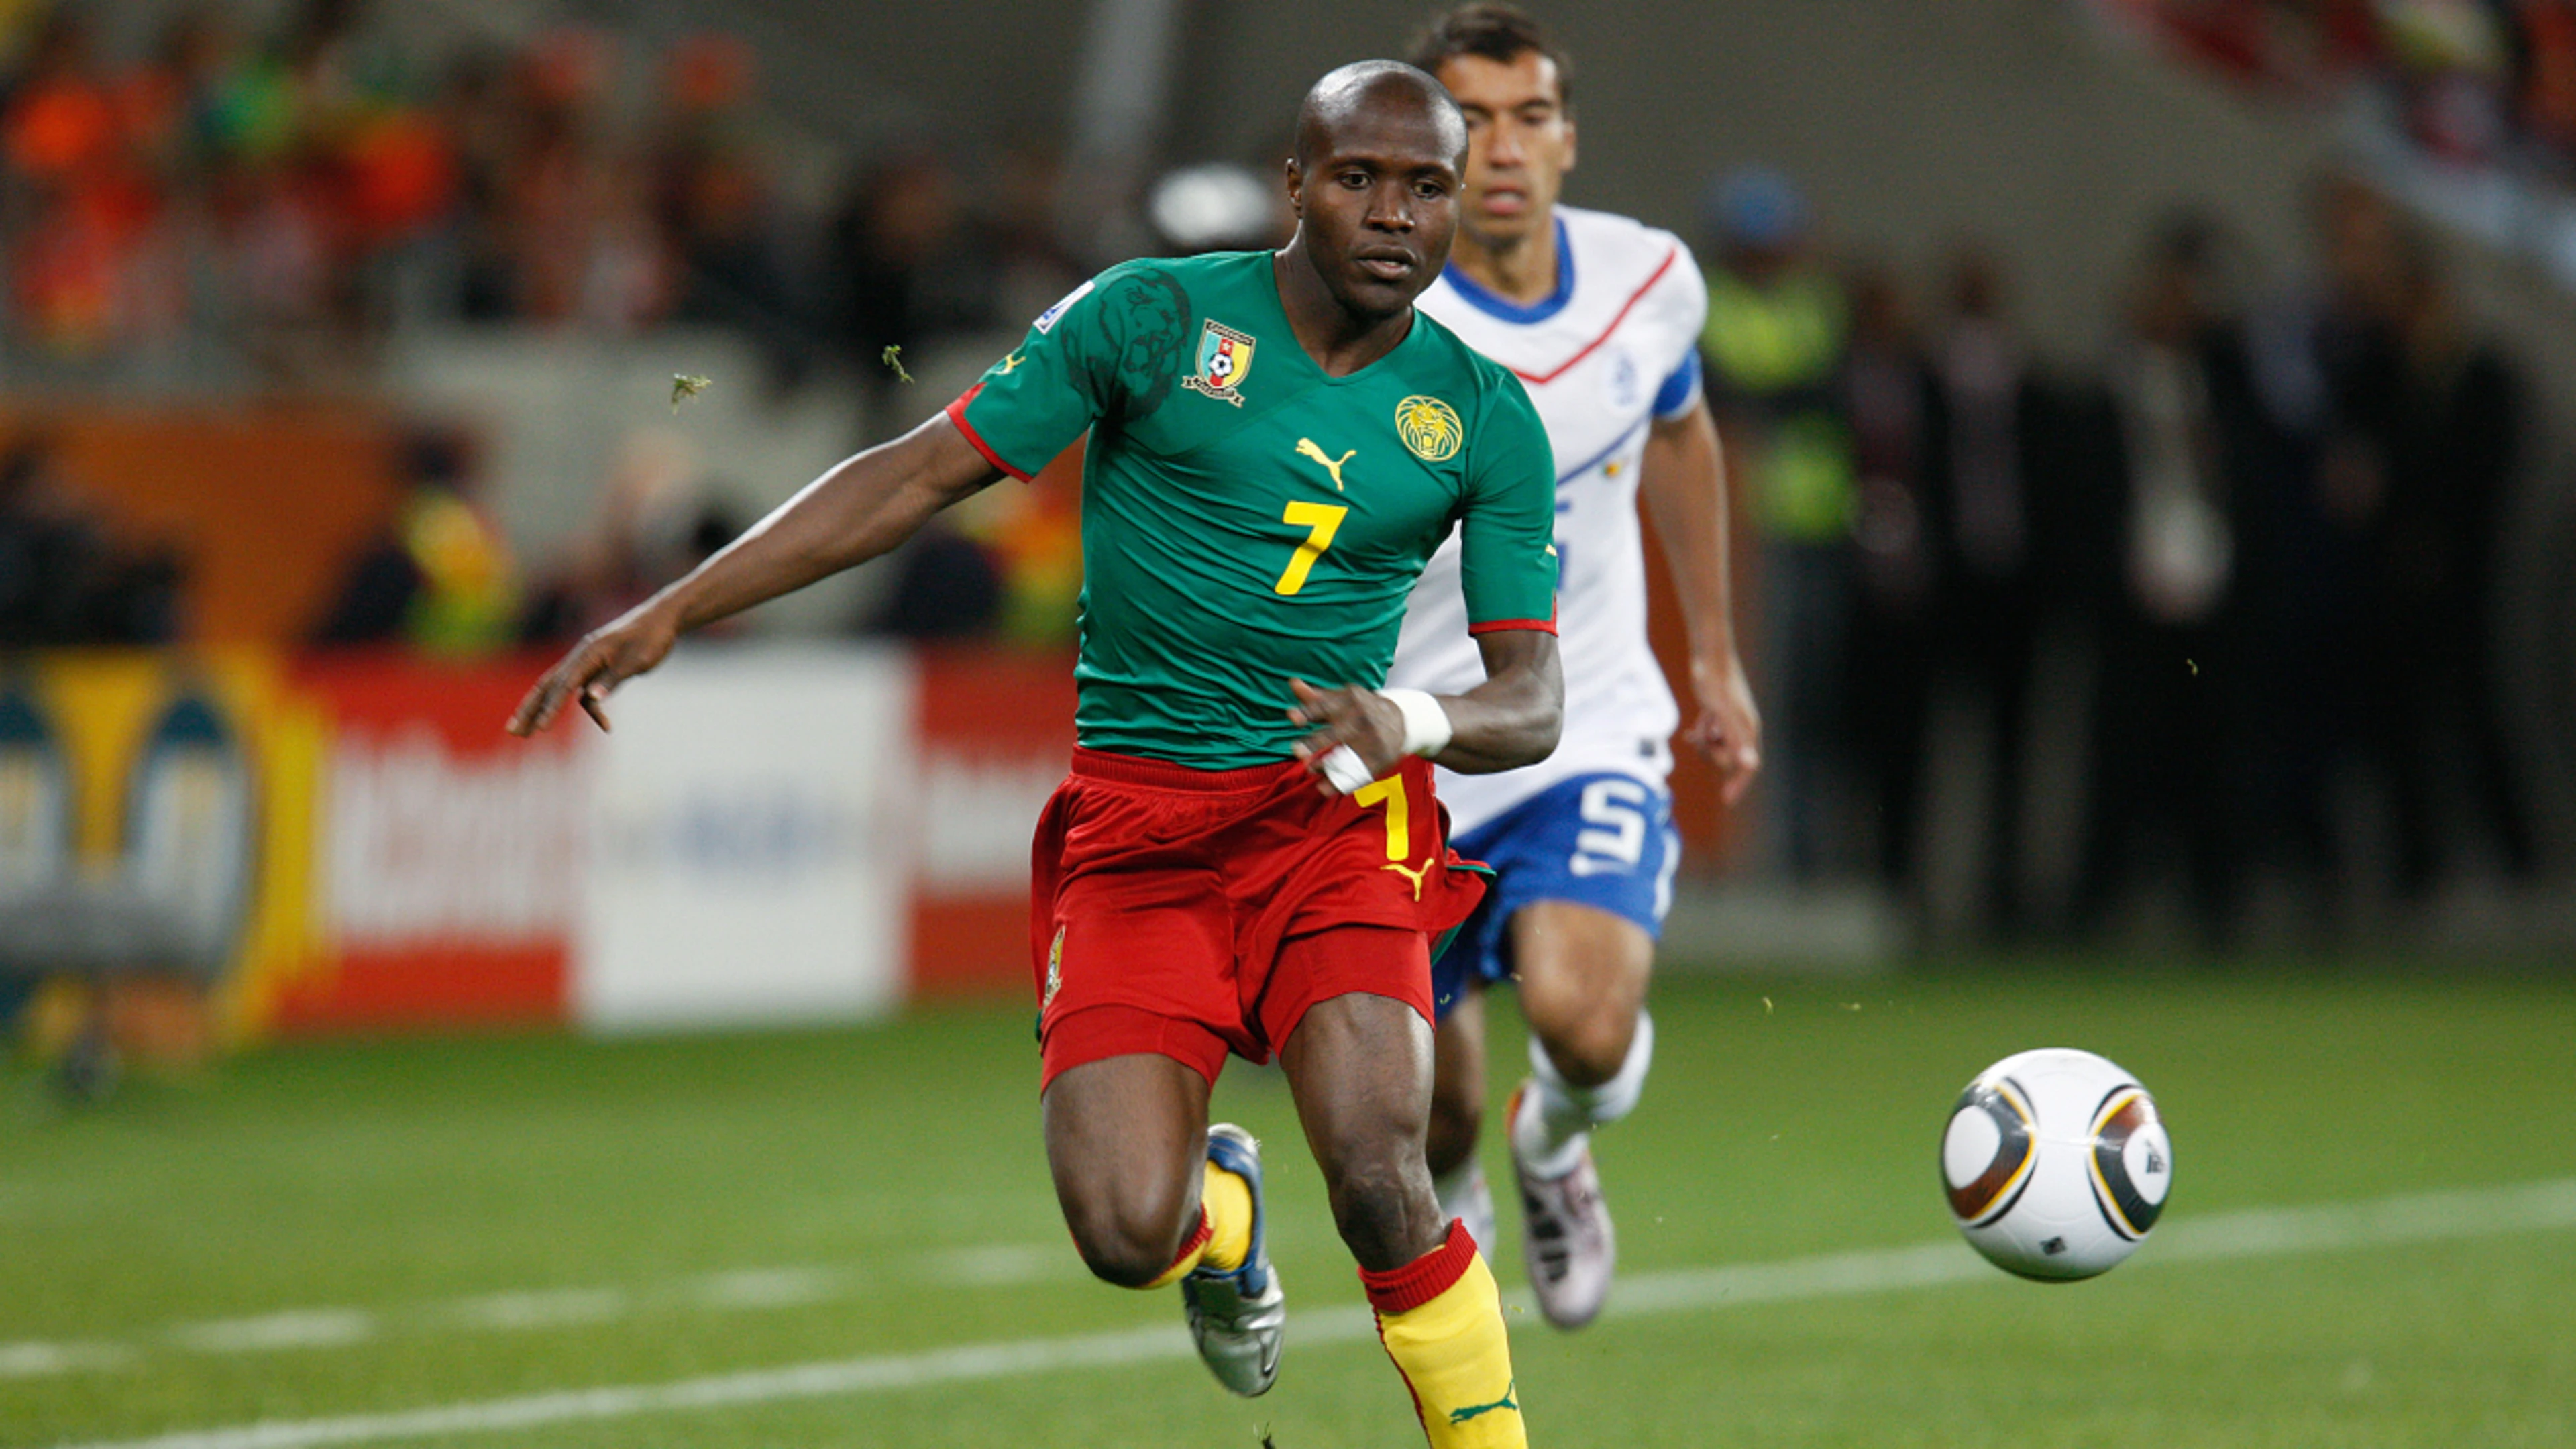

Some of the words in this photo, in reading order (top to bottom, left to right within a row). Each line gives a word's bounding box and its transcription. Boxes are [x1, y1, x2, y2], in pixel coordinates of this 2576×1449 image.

[1275, 500, 1348, 596] 7
[1352, 773, 1409, 861] 7
[1576, 780, 1646, 865] 5
